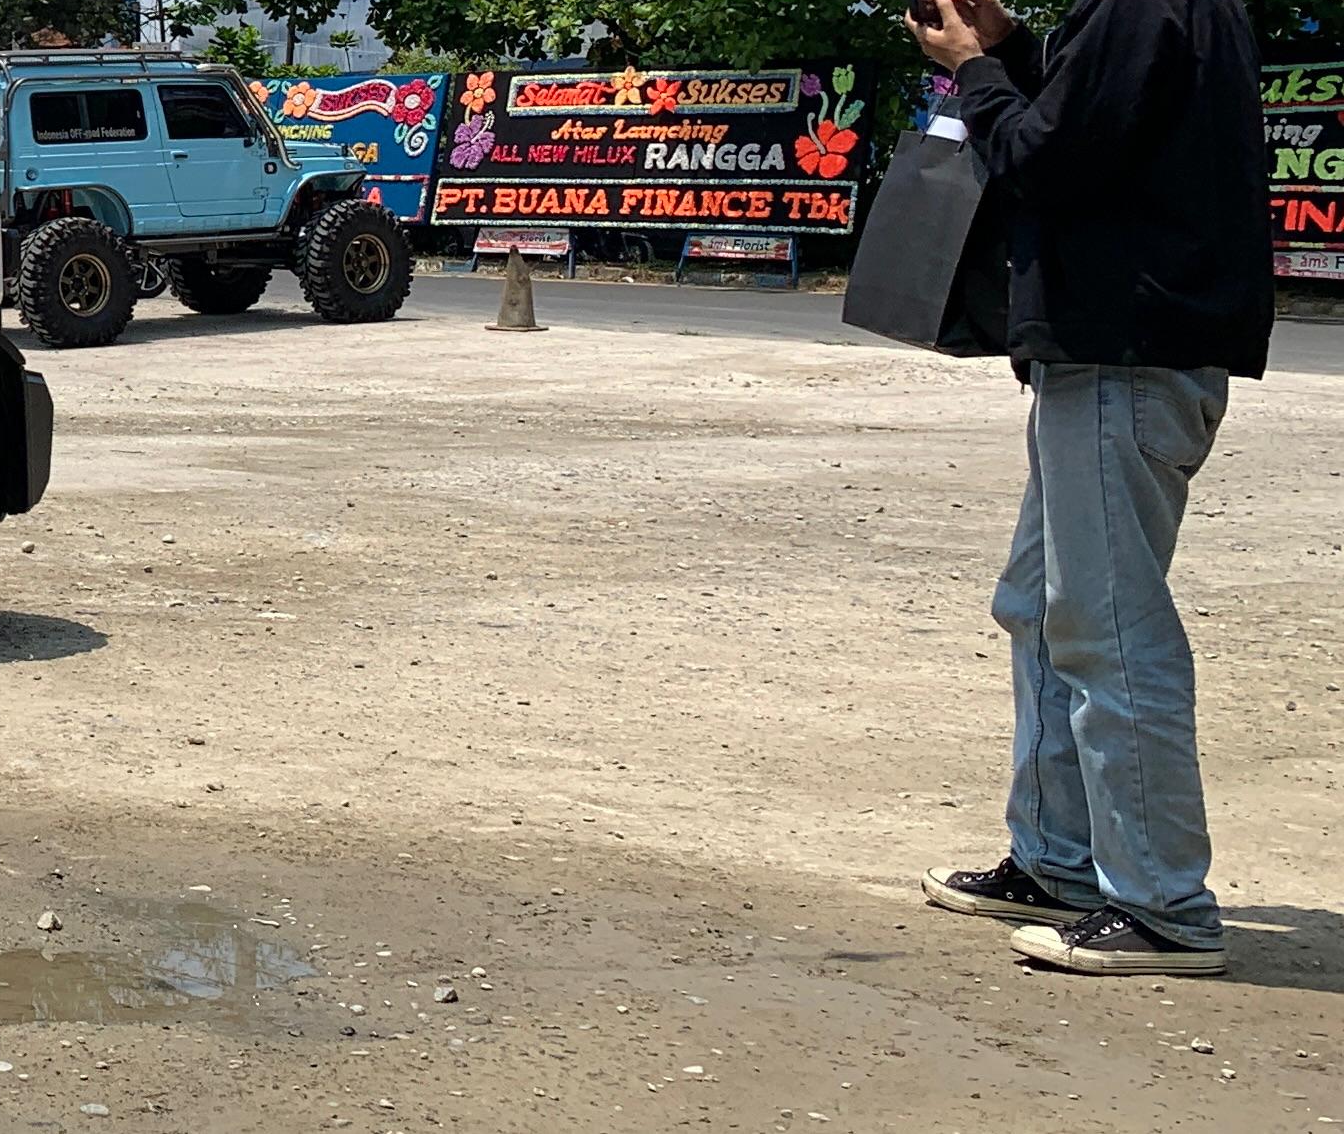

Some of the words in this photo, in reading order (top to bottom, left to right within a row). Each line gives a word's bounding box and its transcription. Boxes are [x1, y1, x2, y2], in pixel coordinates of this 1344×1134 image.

[677, 78, 786, 105] Sukses
[612, 119, 729, 143] Launching
[490, 146, 522, 163] ALL
[527, 145, 569, 163] NEW
[574, 145, 637, 165] HILUX
[644, 143, 785, 170] RANGGA
[492, 188, 610, 215] BUANA
[619, 189, 773, 219] FINANCE
[782, 192, 849, 225] Tbk
[732, 238, 770, 251] Florist
